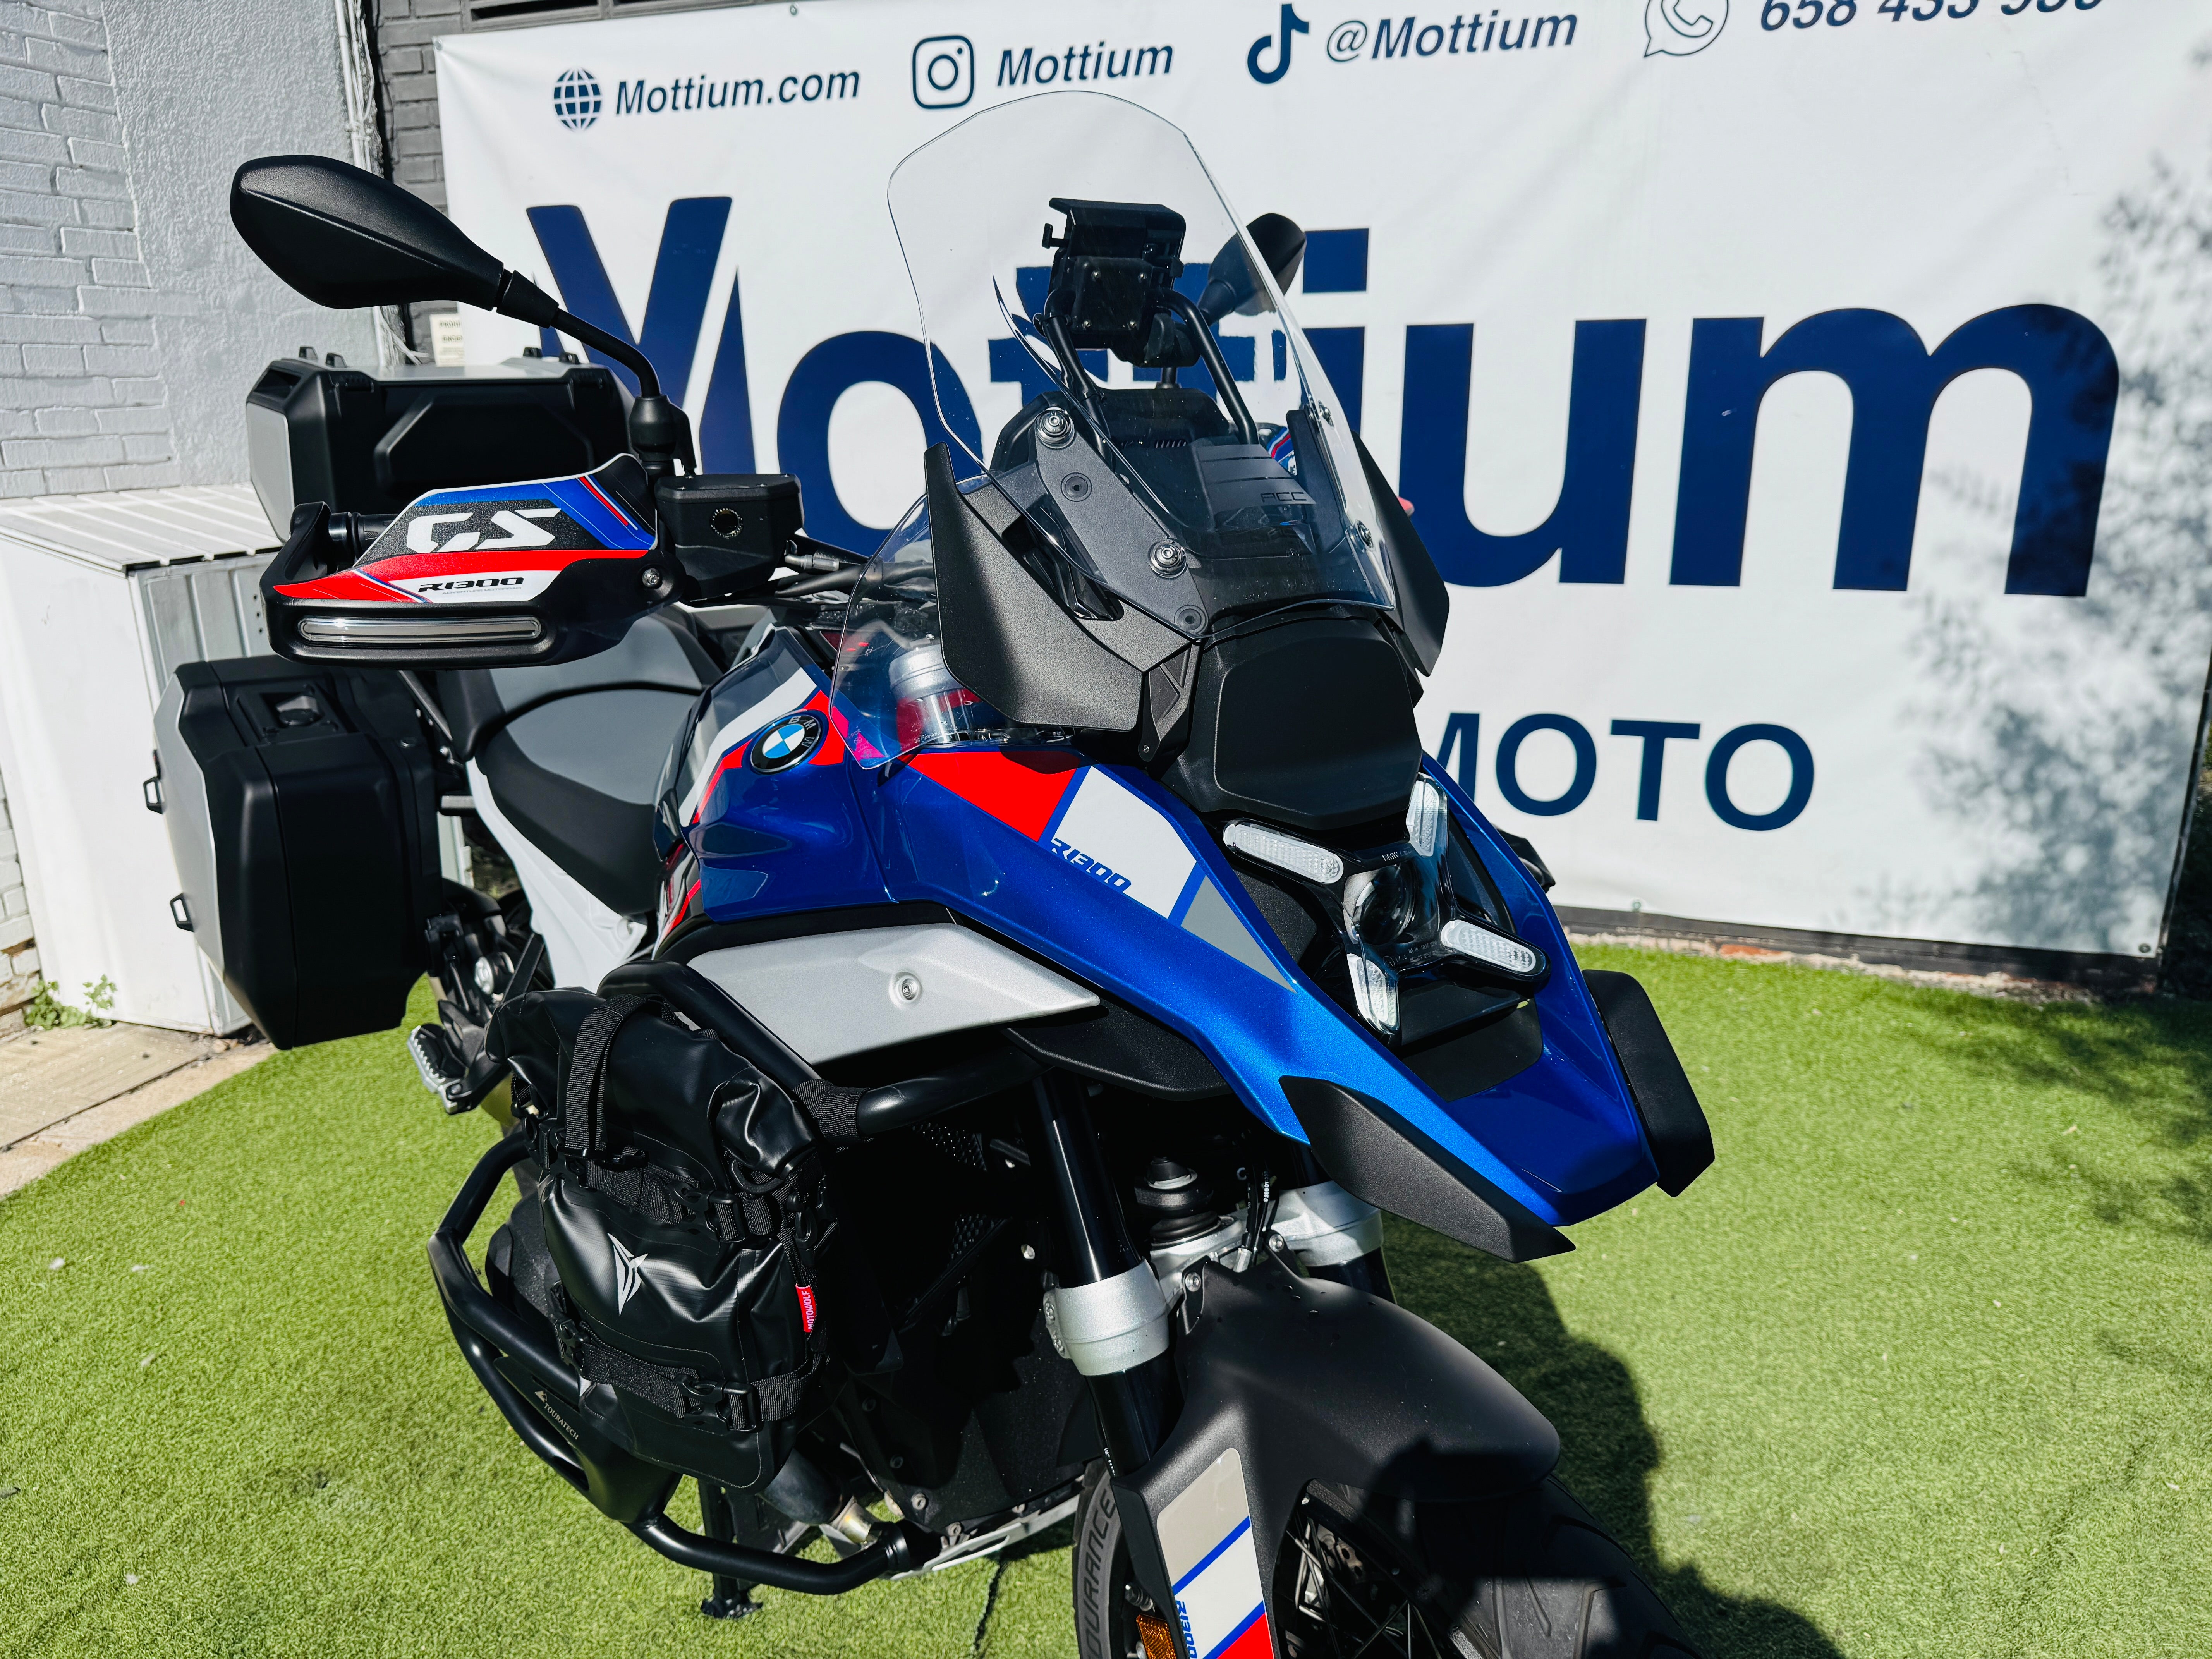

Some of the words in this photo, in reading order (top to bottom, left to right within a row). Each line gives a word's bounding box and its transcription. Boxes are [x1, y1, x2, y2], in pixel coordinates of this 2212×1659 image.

[1761, 0, 1856, 31] 658
[1327, 10, 1577, 62] @Mottium
[997, 41, 1173, 86] Mottium
[616, 72, 859, 114] Mottium.com
[1260, 492, 1307, 503] ACC
[406, 508, 562, 553] GS
[418, 577, 524, 592] R1300
[788, 715, 817, 748] BMW
[1051, 838, 1132, 893] R1300
[801, 1290, 815, 1329] MOTOWOLF
[544, 1402, 579, 1440] TOURATECH
[1175, 1600, 1198, 1659] R1300
